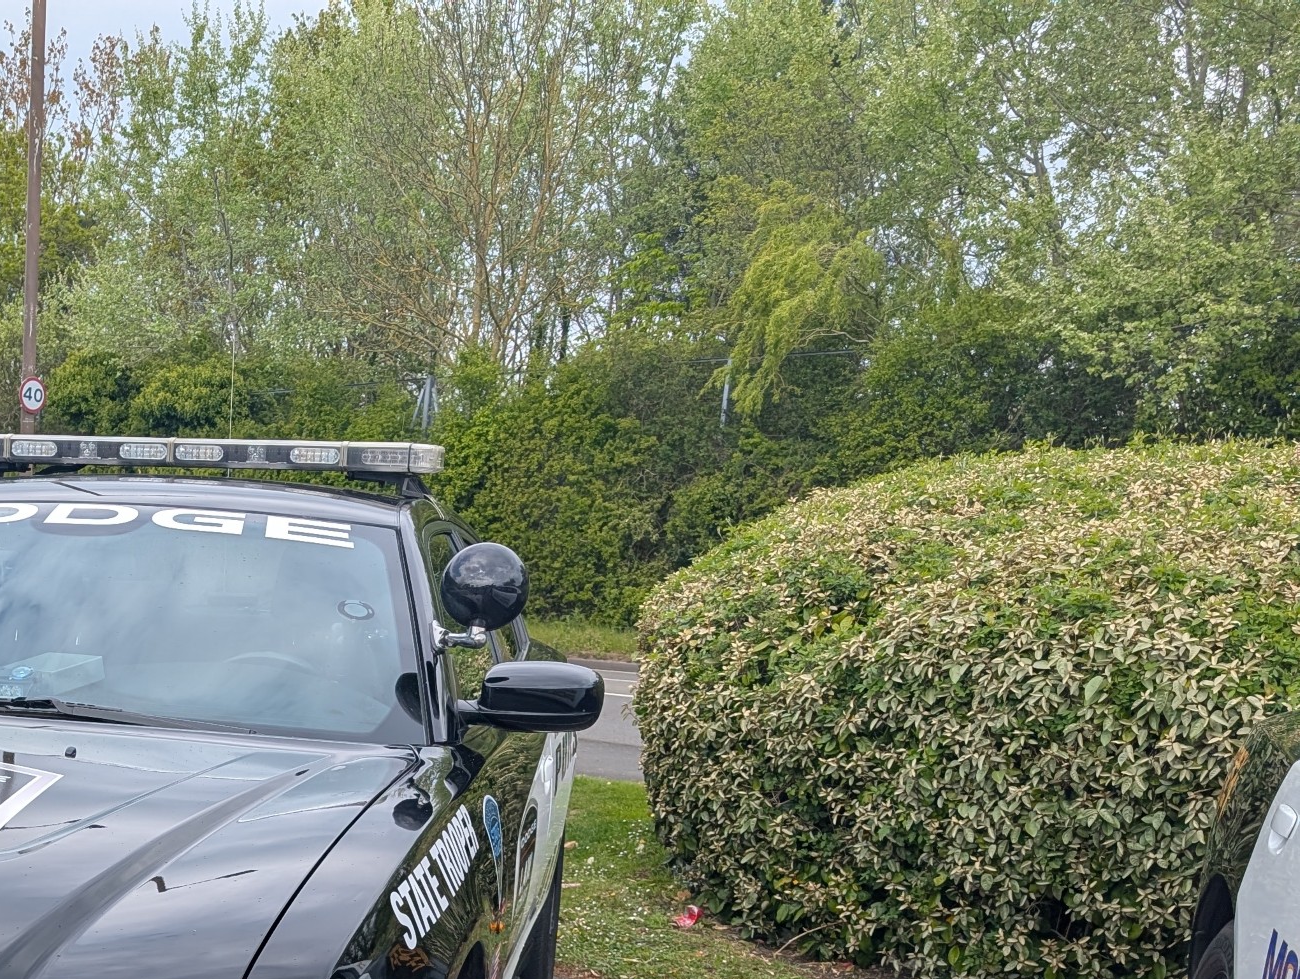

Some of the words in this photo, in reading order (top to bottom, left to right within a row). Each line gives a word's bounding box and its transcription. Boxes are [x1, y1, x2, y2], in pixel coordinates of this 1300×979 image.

[23, 387, 43, 403] 40
[389, 855, 450, 950] STATE
[429, 804, 480, 898] TROOPER
